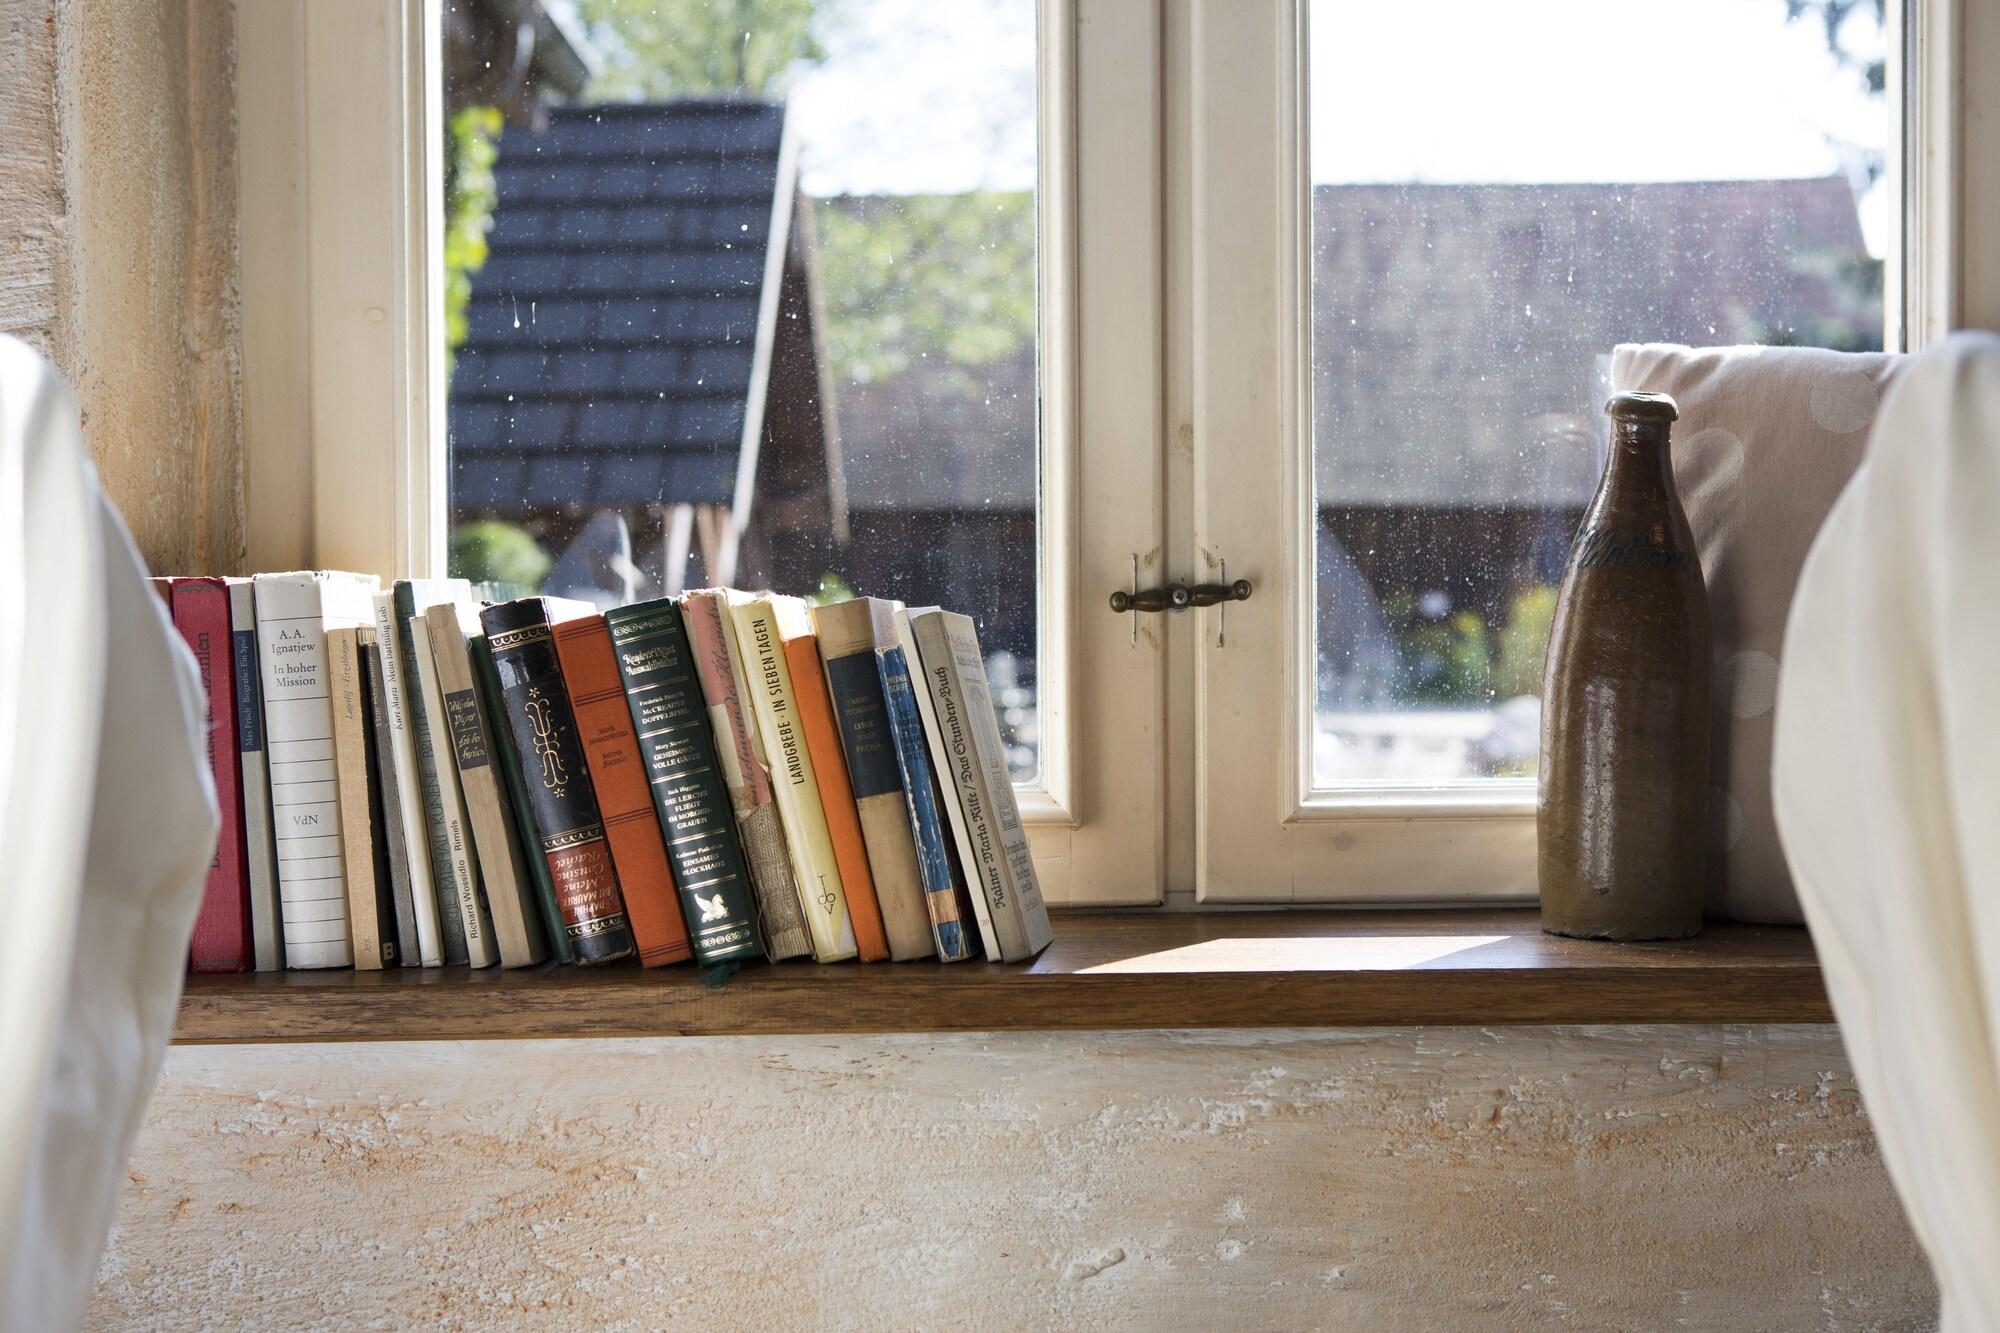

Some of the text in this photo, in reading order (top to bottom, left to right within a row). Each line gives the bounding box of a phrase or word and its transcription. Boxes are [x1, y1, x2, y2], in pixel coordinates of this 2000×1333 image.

[379, 606, 388, 624] Lob
[752, 618, 772, 655] TAGEN
[271, 642, 315, 656] Ignatjew
[273, 661, 317, 675] In hoher
[388, 660, 397, 682] Mein
[276, 676, 316, 687] Mission
[761, 656, 783, 698] SIEBEN
[772, 699, 787, 713] IN
[394, 711, 403, 730] Kurt
[778, 720, 805, 785] LANDGREBE
[652, 759, 677, 769] VOLLE
[959, 756, 972, 783] Das
[664, 797, 678, 806] DIE
[675, 801, 701, 812] FLIEGT
[968, 792, 983, 823] Rilke
[293, 814, 319, 826] VdN
[668, 815, 678, 823] IM
[677, 817, 707, 829] GRAUEN
[976, 822, 994, 864] Maria
[555, 852, 600, 869] Rachel
[450, 819, 479, 939] Richard Wossidlo Rimels
[556, 865, 605, 881] Cousine
[563, 876, 603, 892] Meine
[988, 867, 1006, 909] Rainer
